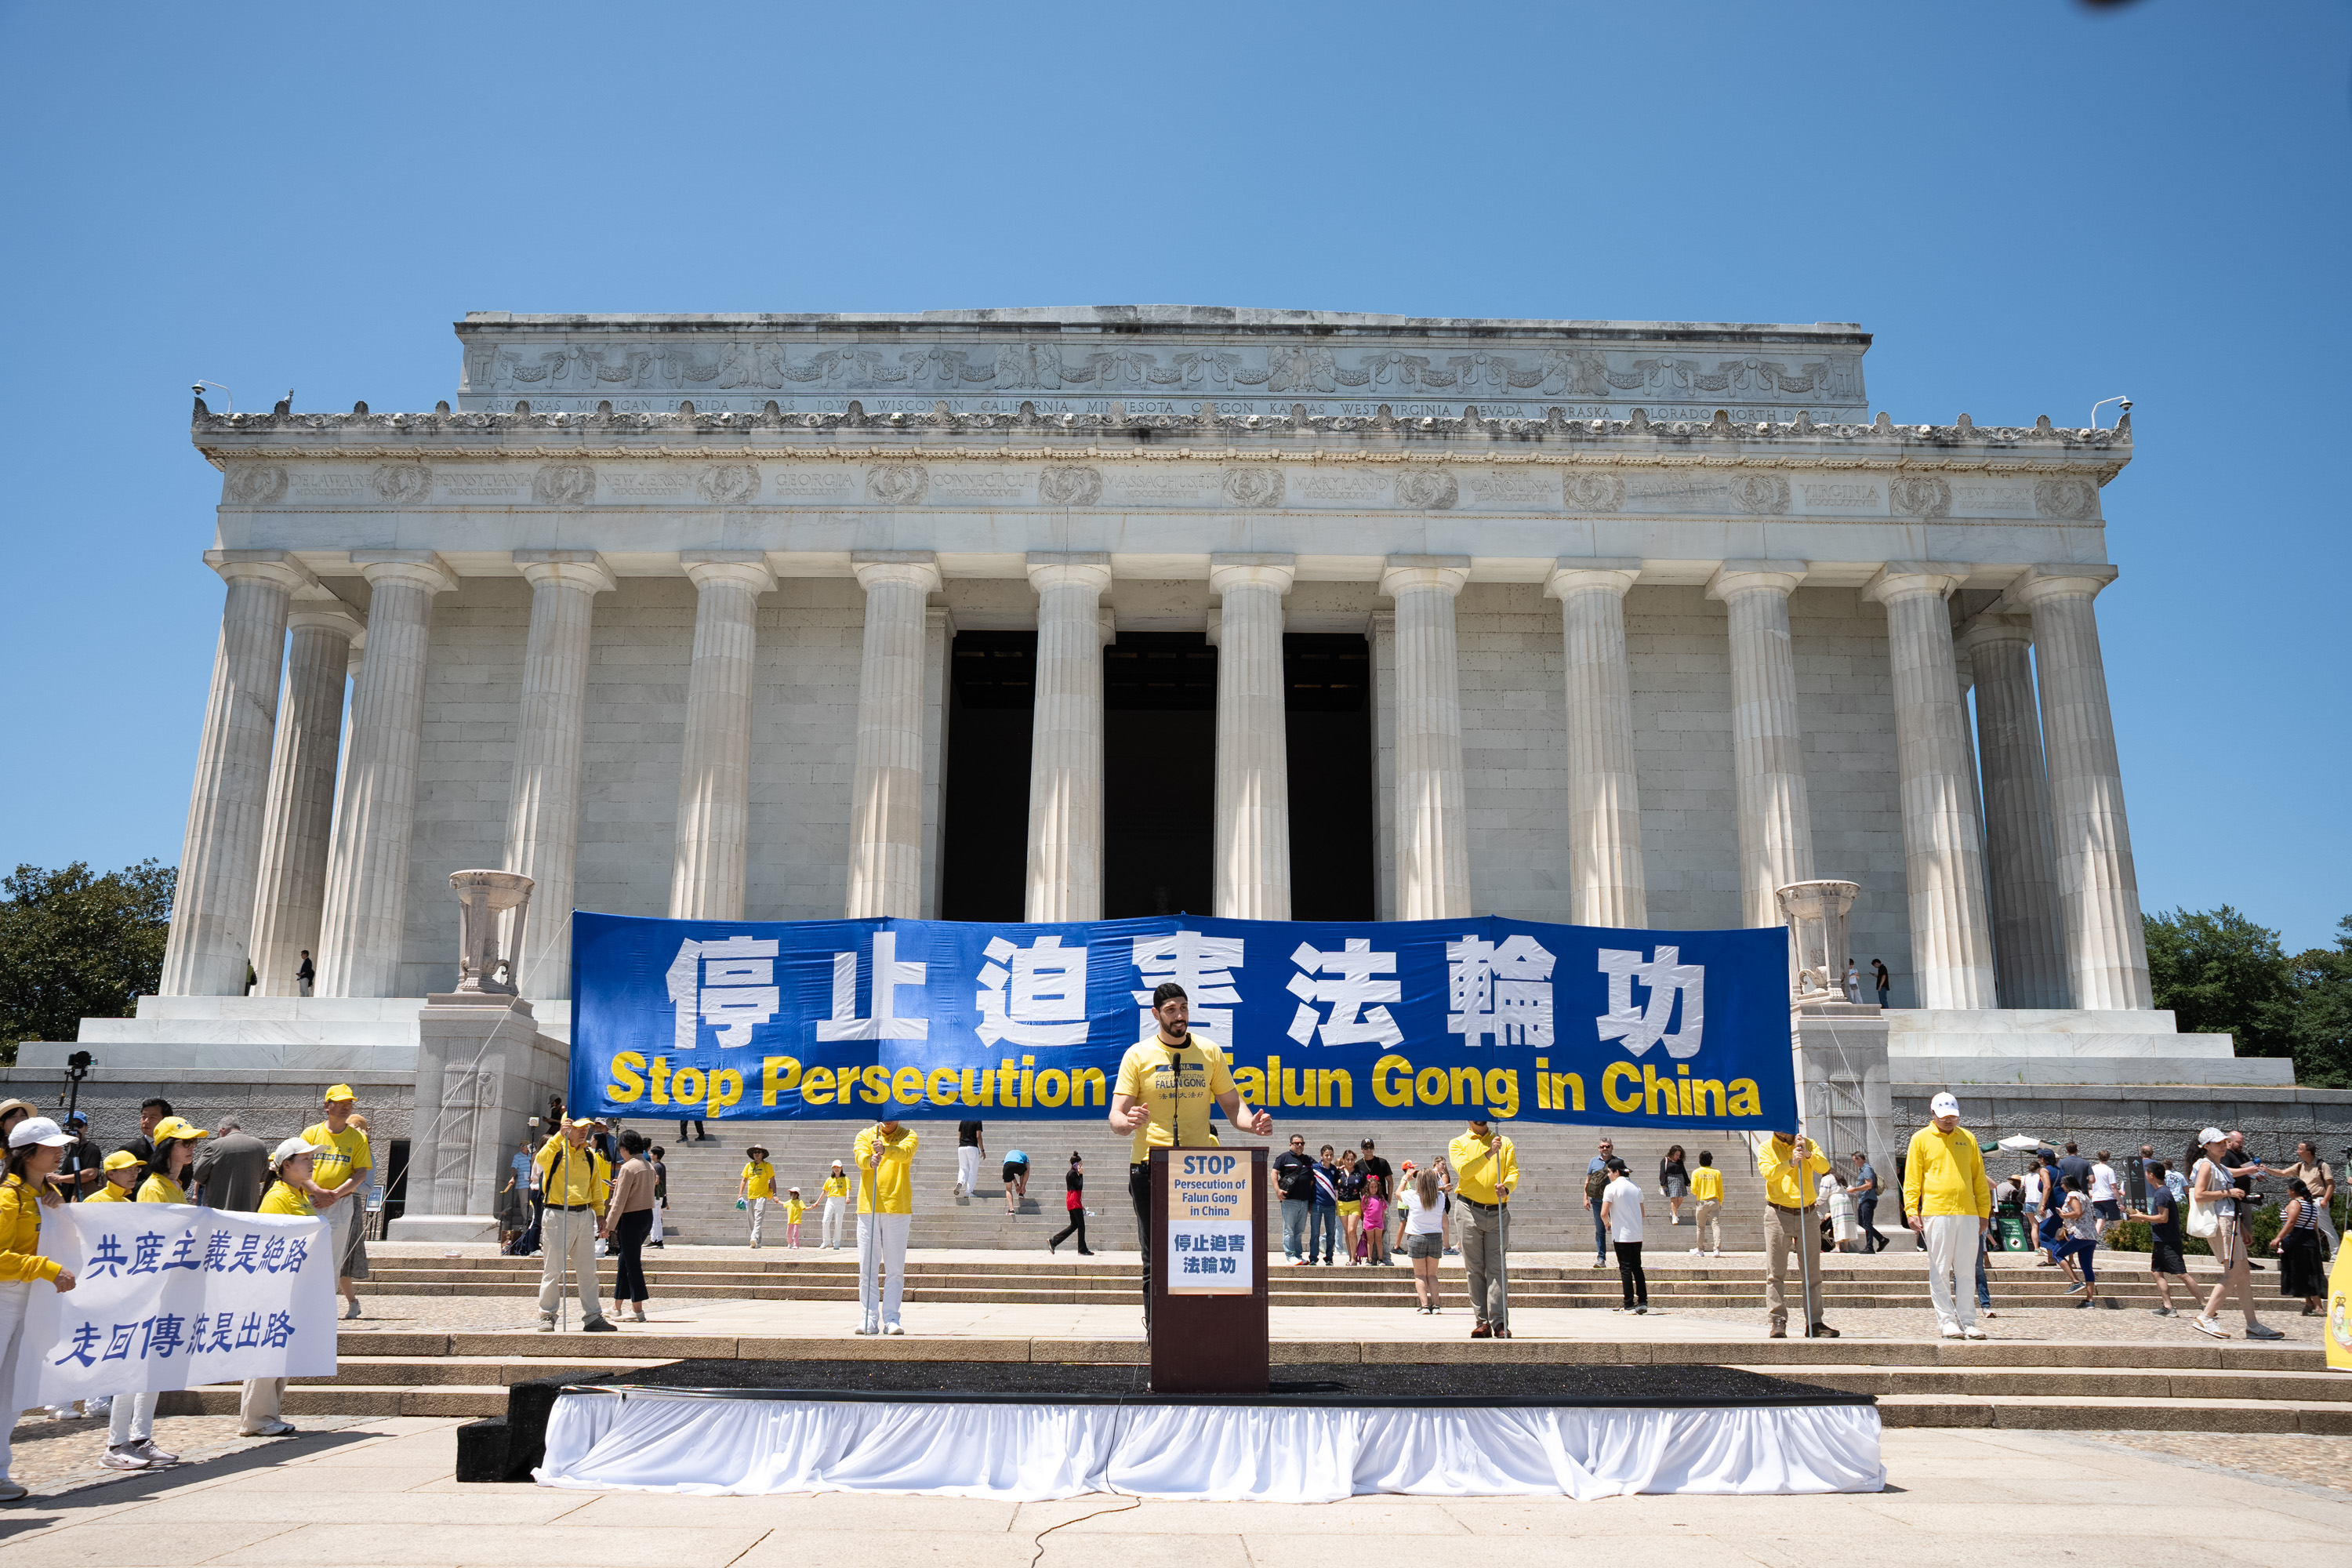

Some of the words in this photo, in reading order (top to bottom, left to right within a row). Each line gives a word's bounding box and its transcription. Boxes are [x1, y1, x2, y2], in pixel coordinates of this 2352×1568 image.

[485, 400, 561, 411] ARKNSAS
[668, 400, 729, 411] FLRIDA
[750, 400, 795, 411] TEAS
[818, 400, 851, 411] IOW
[877, 400, 964, 412] WISCONIN
[981, 401, 1069, 412] CALIFRNIA
[1192, 402, 1254, 413] OEGON
[1270, 403, 1325, 414] KANAS
[1341, 404, 1378, 415] WEST
[1540, 406, 1613, 418] NBRASKA
[1726, 409, 1777, 421] NORTH
[1784, 410, 1840, 422] DOTA
[289, 474, 372, 488] DELAWARE
[434, 473, 535, 487] PENNSYLVANIA
[601, 474, 638, 487] NEW
[639, 474, 697, 487] JERSEY
[775, 474, 855, 487] GEORGIA
[932, 472, 1037, 488] CONNECTICUT
[1103, 474, 1221, 489] MASSACHUSETTS
[1491, 471, 1530, 480] SOUTH
[1663, 474, 1691, 482] NEW
[1293, 477, 1388, 491] MARYLAND
[1468, 480, 1552, 493] CAROLINA
[1629, 482, 1726, 496] HAMPSHIRE
[1799, 484, 1881, 499] VIRGINIA
[1952, 487, 1988, 500] NEW
[1992, 487, 2034, 501] YORK
[665, 930, 1705, 1058] 停止迫害法輪功
[606, 1051, 744, 1119] Stop
[762, 1054, 1106, 1108] Persecution
[1372, 1054, 1519, 1119] Gong
[1536, 1057, 1585, 1110] in
[1602, 1060, 1763, 1117] China
[1156, 1079, 1182, 1089] FALUN
[1184, 1078, 1206, 1088] GONG
[1159, 1091, 1204, 1100] 法輪大法好
[1183, 1155, 1236, 1175] STOP
[1174, 1178, 1233, 1189] Persecution
[1236, 1178, 1247, 1189] of
[1182, 1192, 1210, 1203] Falun
[1211, 1192, 1238, 1205] Gong
[1190, 1205, 1200, 1216] in
[1202, 1205, 1230, 1216] China
[1174, 1234, 1246, 1252] 停止迫害
[1183, 1256, 1236, 1274] 法輪功
[55, 1308, 296, 1368] 走回傳統是出路
